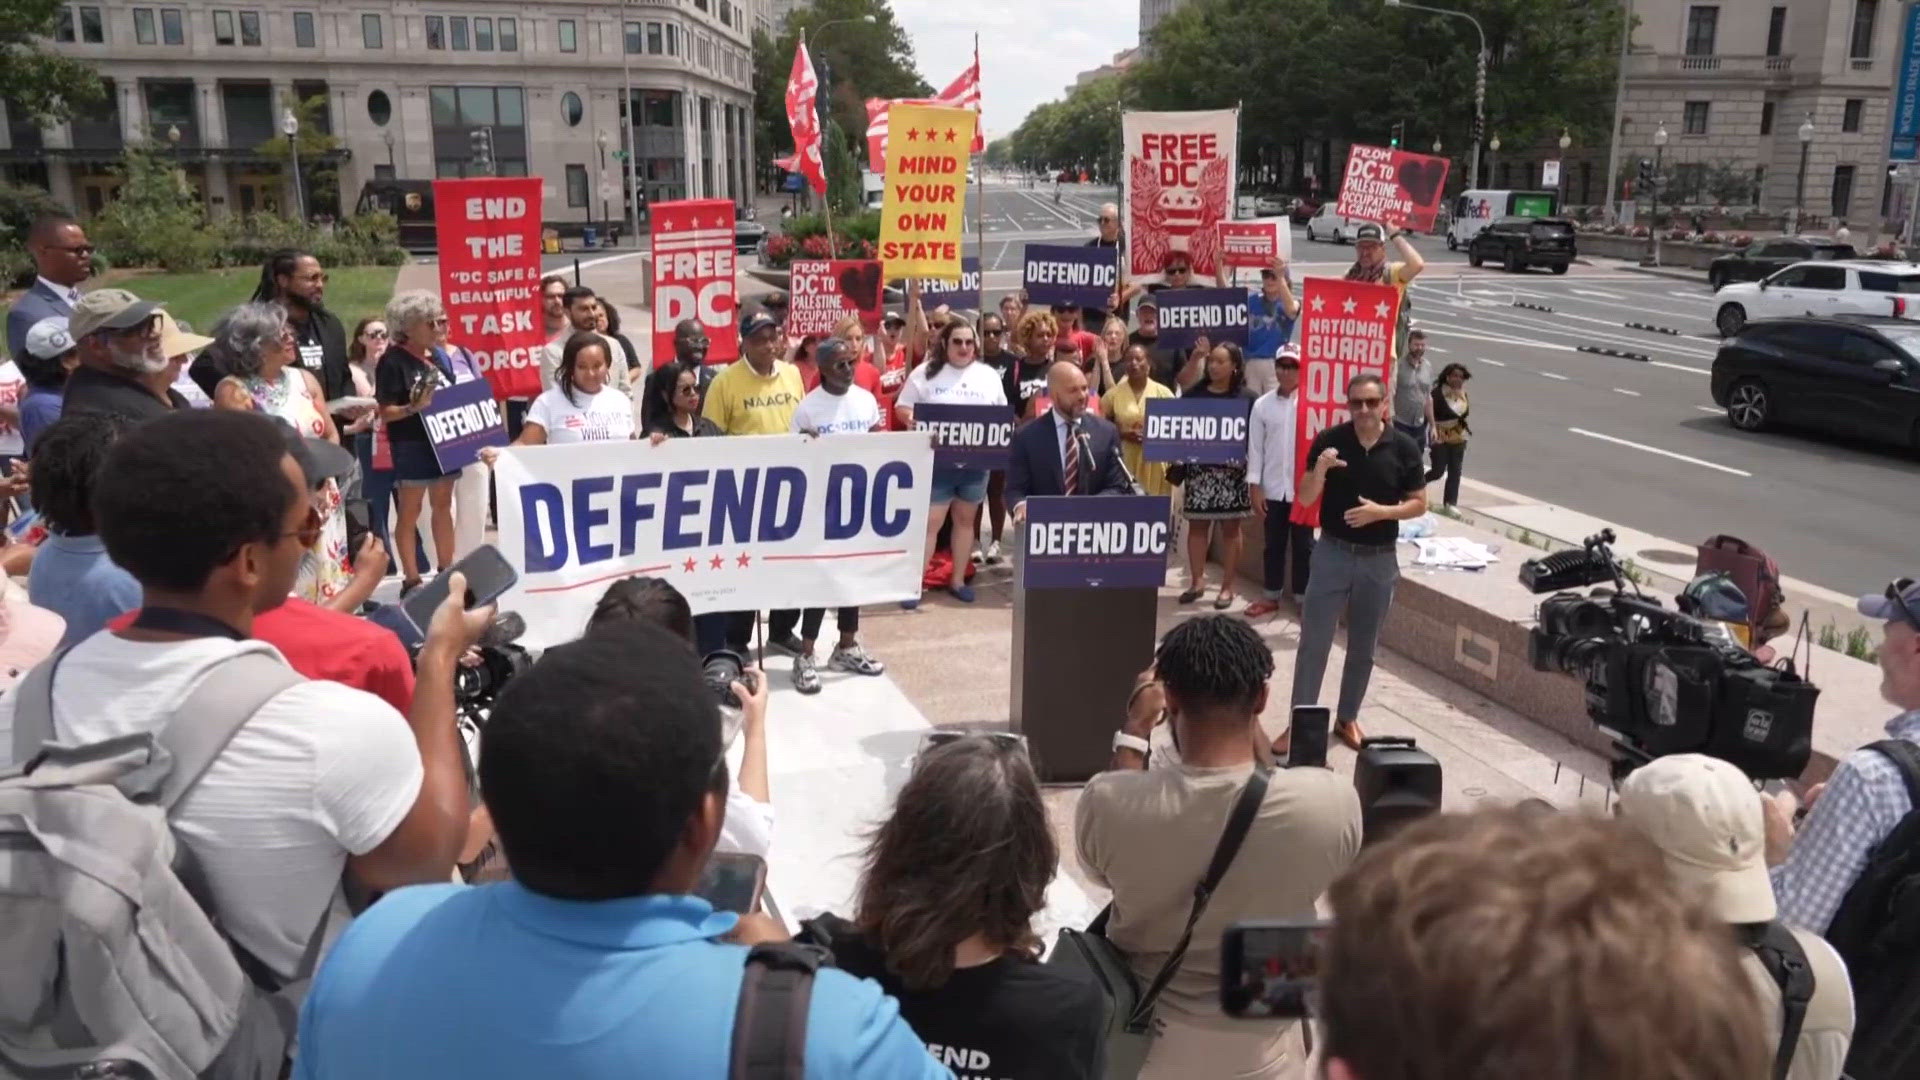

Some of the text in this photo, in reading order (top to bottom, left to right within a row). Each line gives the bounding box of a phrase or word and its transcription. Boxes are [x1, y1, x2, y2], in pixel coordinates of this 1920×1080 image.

[1141, 133, 1217, 161] FREE
[1352, 146, 1392, 162] FROM
[898, 155, 957, 174] MIND
[1159, 161, 1199, 188] DC
[1347, 158, 1394, 180] DC TO
[895, 184, 956, 204] YOUR
[1344, 178, 1398, 199] PALESTINE
[465, 197, 526, 221] END
[1338, 203, 1383, 221] A CRIME
[1341, 191, 1413, 213] OCCUPATION IS
[897, 213, 947, 232] OWN
[465, 234, 523, 259] THE
[883, 241, 956, 260] STATE
[1254, 245, 1272, 254] DC
[487, 267, 523, 284] SAFE
[527, 266, 537, 280] &
[655, 250, 733, 281] FREE
[792, 262, 830, 274] FROM
[1027, 260, 1115, 287] DEFEND DC
[791, 275, 836, 295] DC TO
[905, 271, 980, 294] FEND DC
[655, 280, 733, 333] DC
[791, 295, 842, 310] PALESTINE
[460, 310, 533, 336] TASK
[791, 309, 849, 322] OCCUPATION
[1159, 303, 1248, 329] DEFEND DC
[790, 321, 834, 335] A CRIME
[1309, 318, 1387, 340] NATIONAL
[474, 346, 544, 372] ORCE
[1307, 335, 1386, 366] GUARD
[743, 392, 792, 410] NAACP
[426, 397, 501, 444] DEFEND DC
[1147, 415, 1246, 440] DEFEND DC
[1306, 406, 1351, 440] NO
[987, 422, 1011, 446] DC
[519, 460, 914, 575] DEFEND DC
[1029, 521, 1167, 555] DEFEND DC
